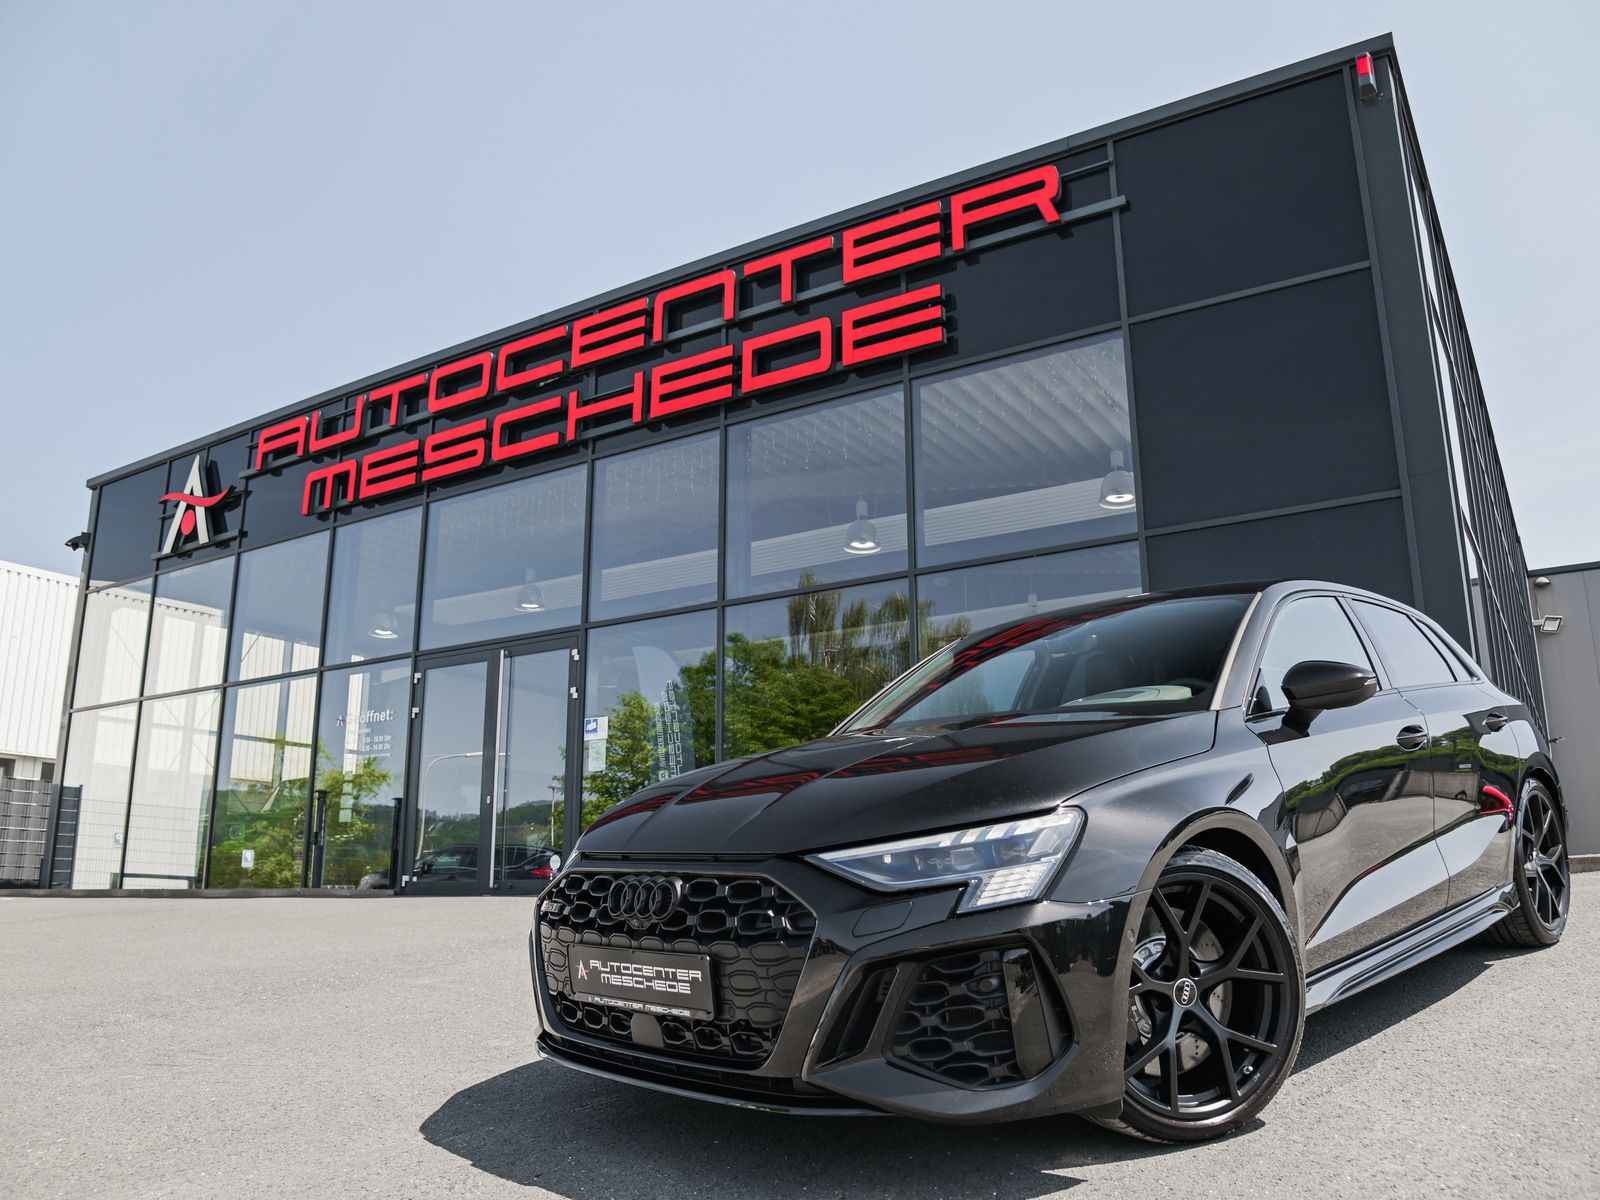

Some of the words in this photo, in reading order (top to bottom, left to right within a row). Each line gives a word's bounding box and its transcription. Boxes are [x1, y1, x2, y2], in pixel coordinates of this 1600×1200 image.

[256, 165, 1061, 470] AUTOCENTER
[302, 284, 945, 514] MESCHEDE
[589, 960, 702, 982] AUTOCENTER
[601, 973, 691, 994] MESCHEDE
[594, 996, 643, 1011] AUTOCENTER
[645, 1003, 691, 1017] MESCHEDE
